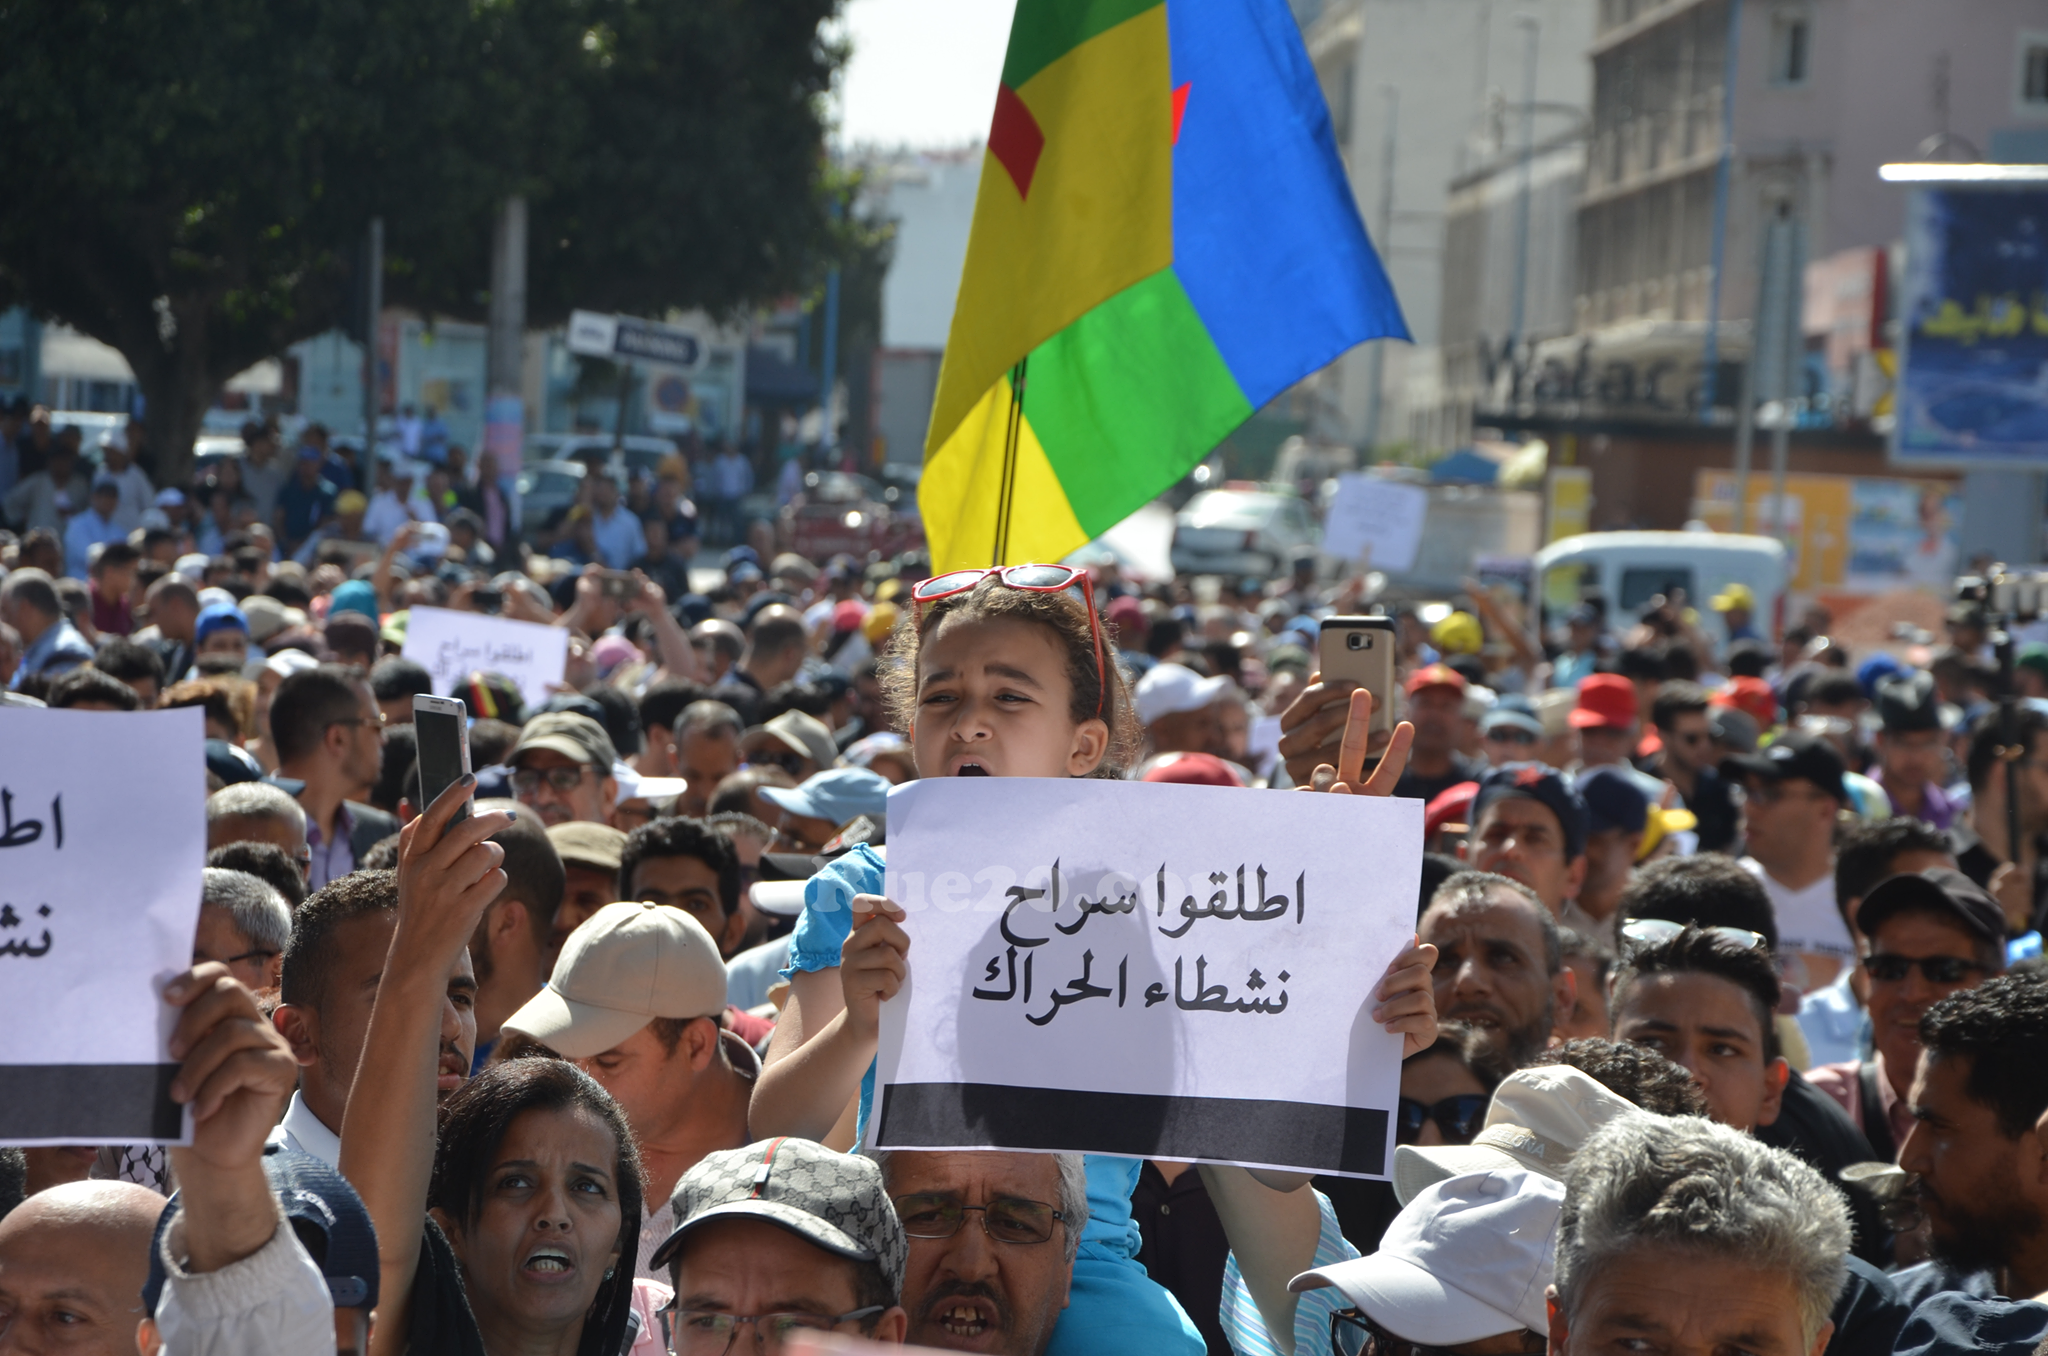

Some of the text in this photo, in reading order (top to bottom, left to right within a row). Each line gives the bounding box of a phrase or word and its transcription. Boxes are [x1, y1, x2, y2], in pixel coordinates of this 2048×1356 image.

[1000, 856, 1305, 948] اطلقوا سراح
[972, 945, 1291, 1026] نشطاء الحراك
